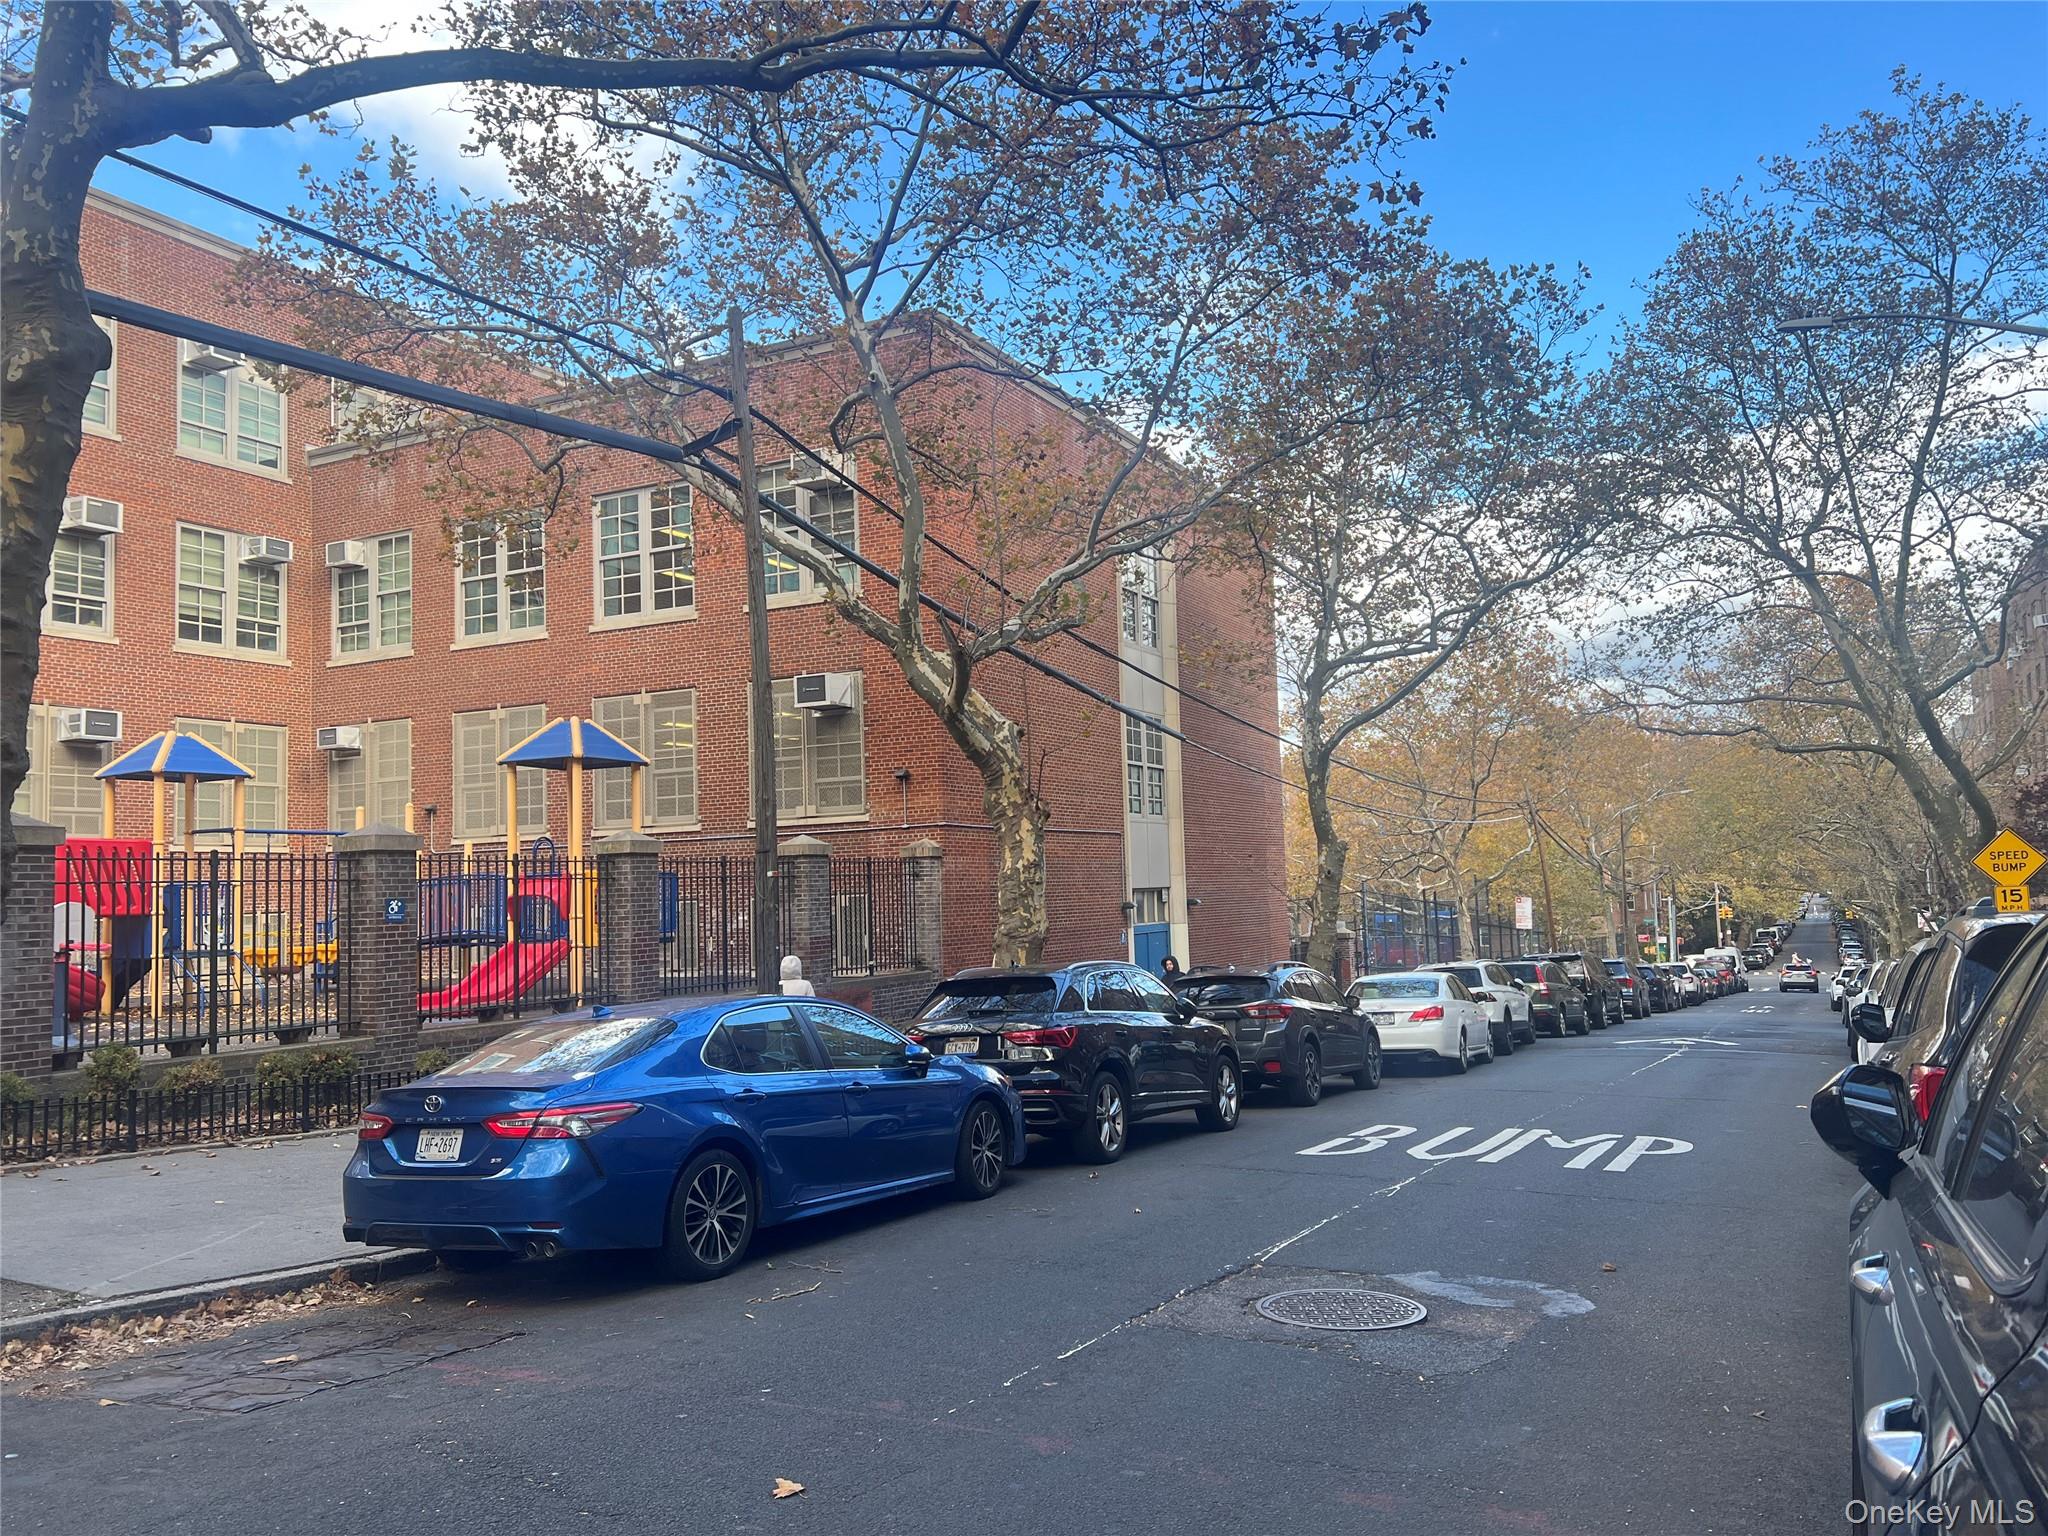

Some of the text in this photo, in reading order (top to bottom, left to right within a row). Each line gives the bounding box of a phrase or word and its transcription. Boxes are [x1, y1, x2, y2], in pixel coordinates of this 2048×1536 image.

[1990, 851, 2028, 860] SPEED
[1993, 863, 2026, 872] BUMP
[2001, 889, 2023, 903] 15
[1294, 1124, 1695, 1172] BUMP
